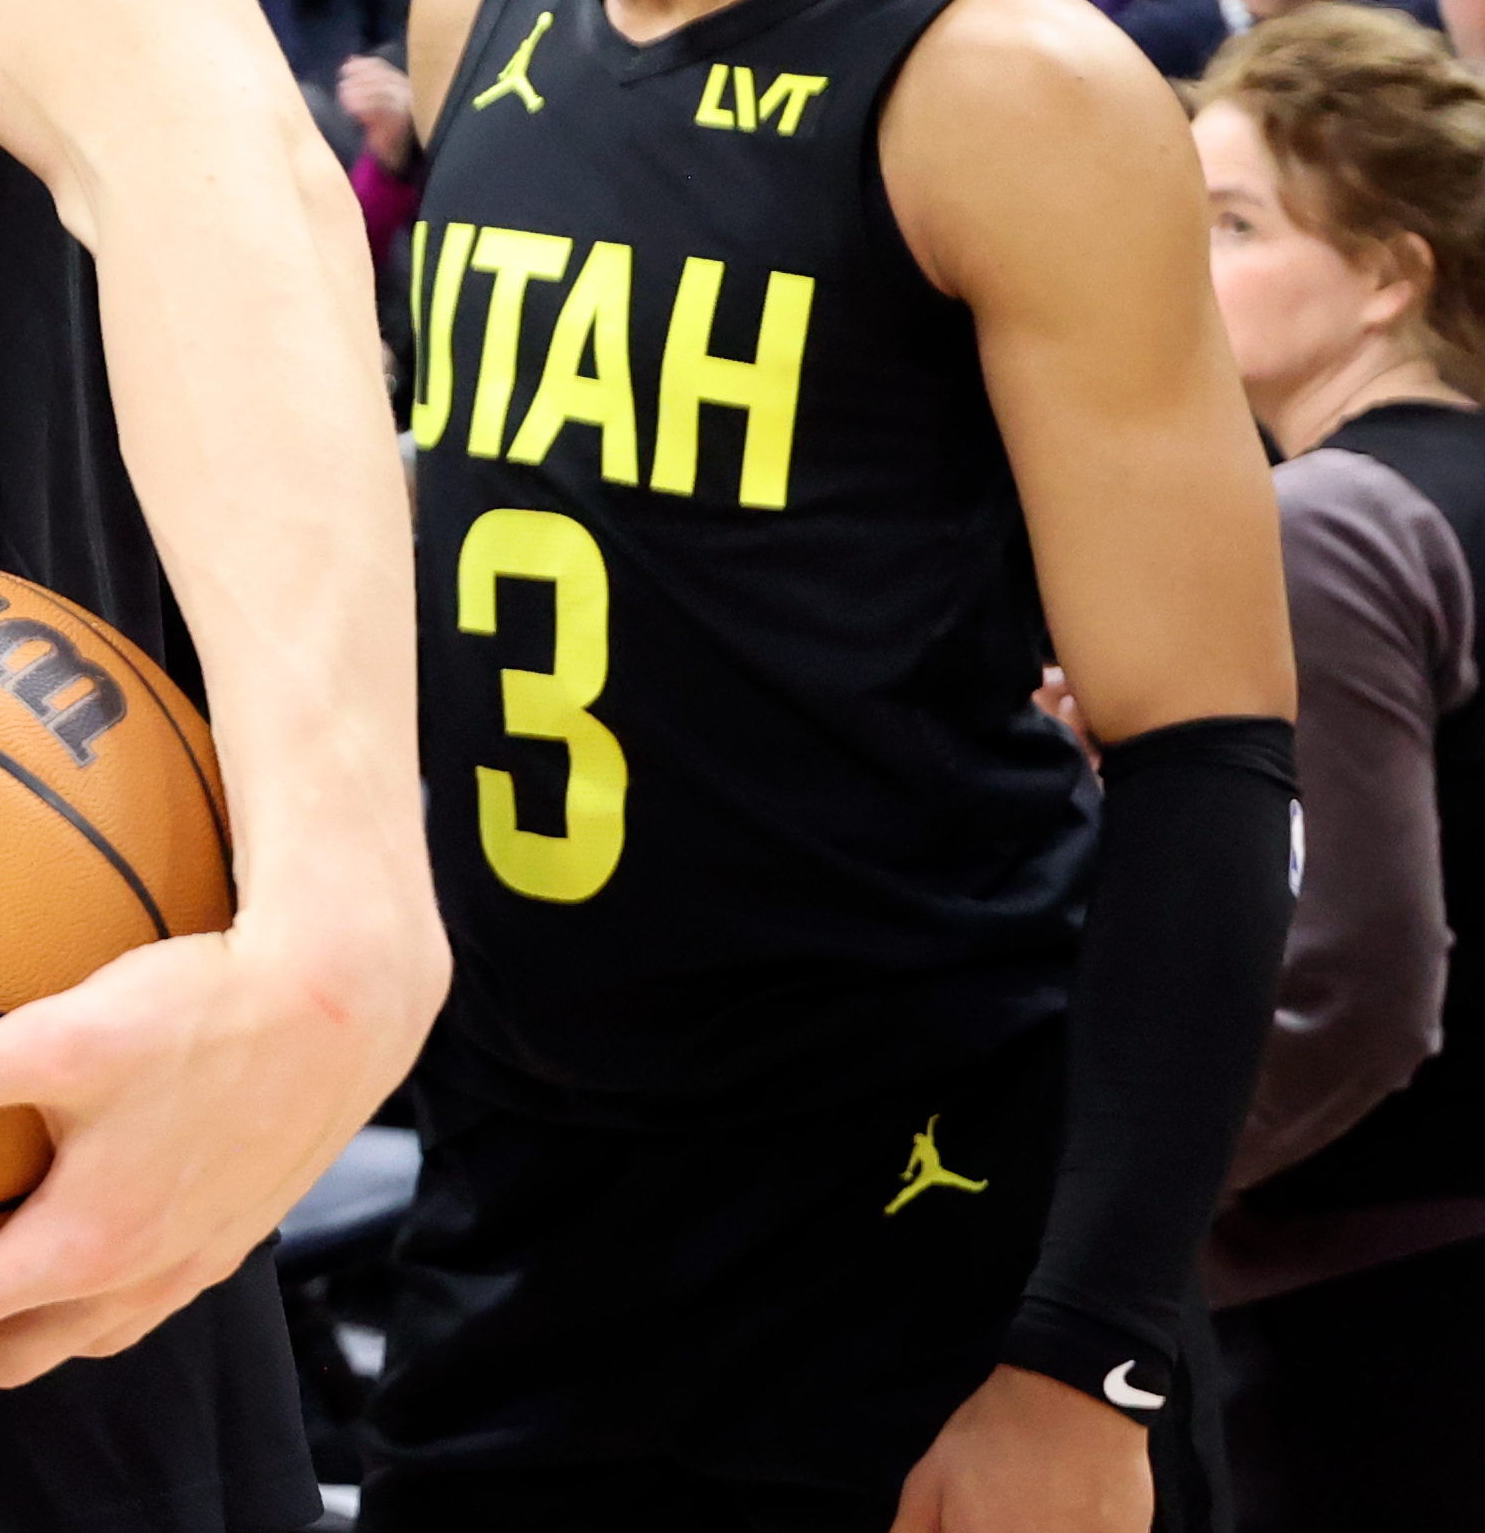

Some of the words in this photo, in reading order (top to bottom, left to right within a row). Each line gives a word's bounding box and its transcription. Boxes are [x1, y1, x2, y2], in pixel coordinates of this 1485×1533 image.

[694, 63, 829, 137] LVT
[410, 219, 815, 511] UTAH
[457, 508, 629, 904] 3
